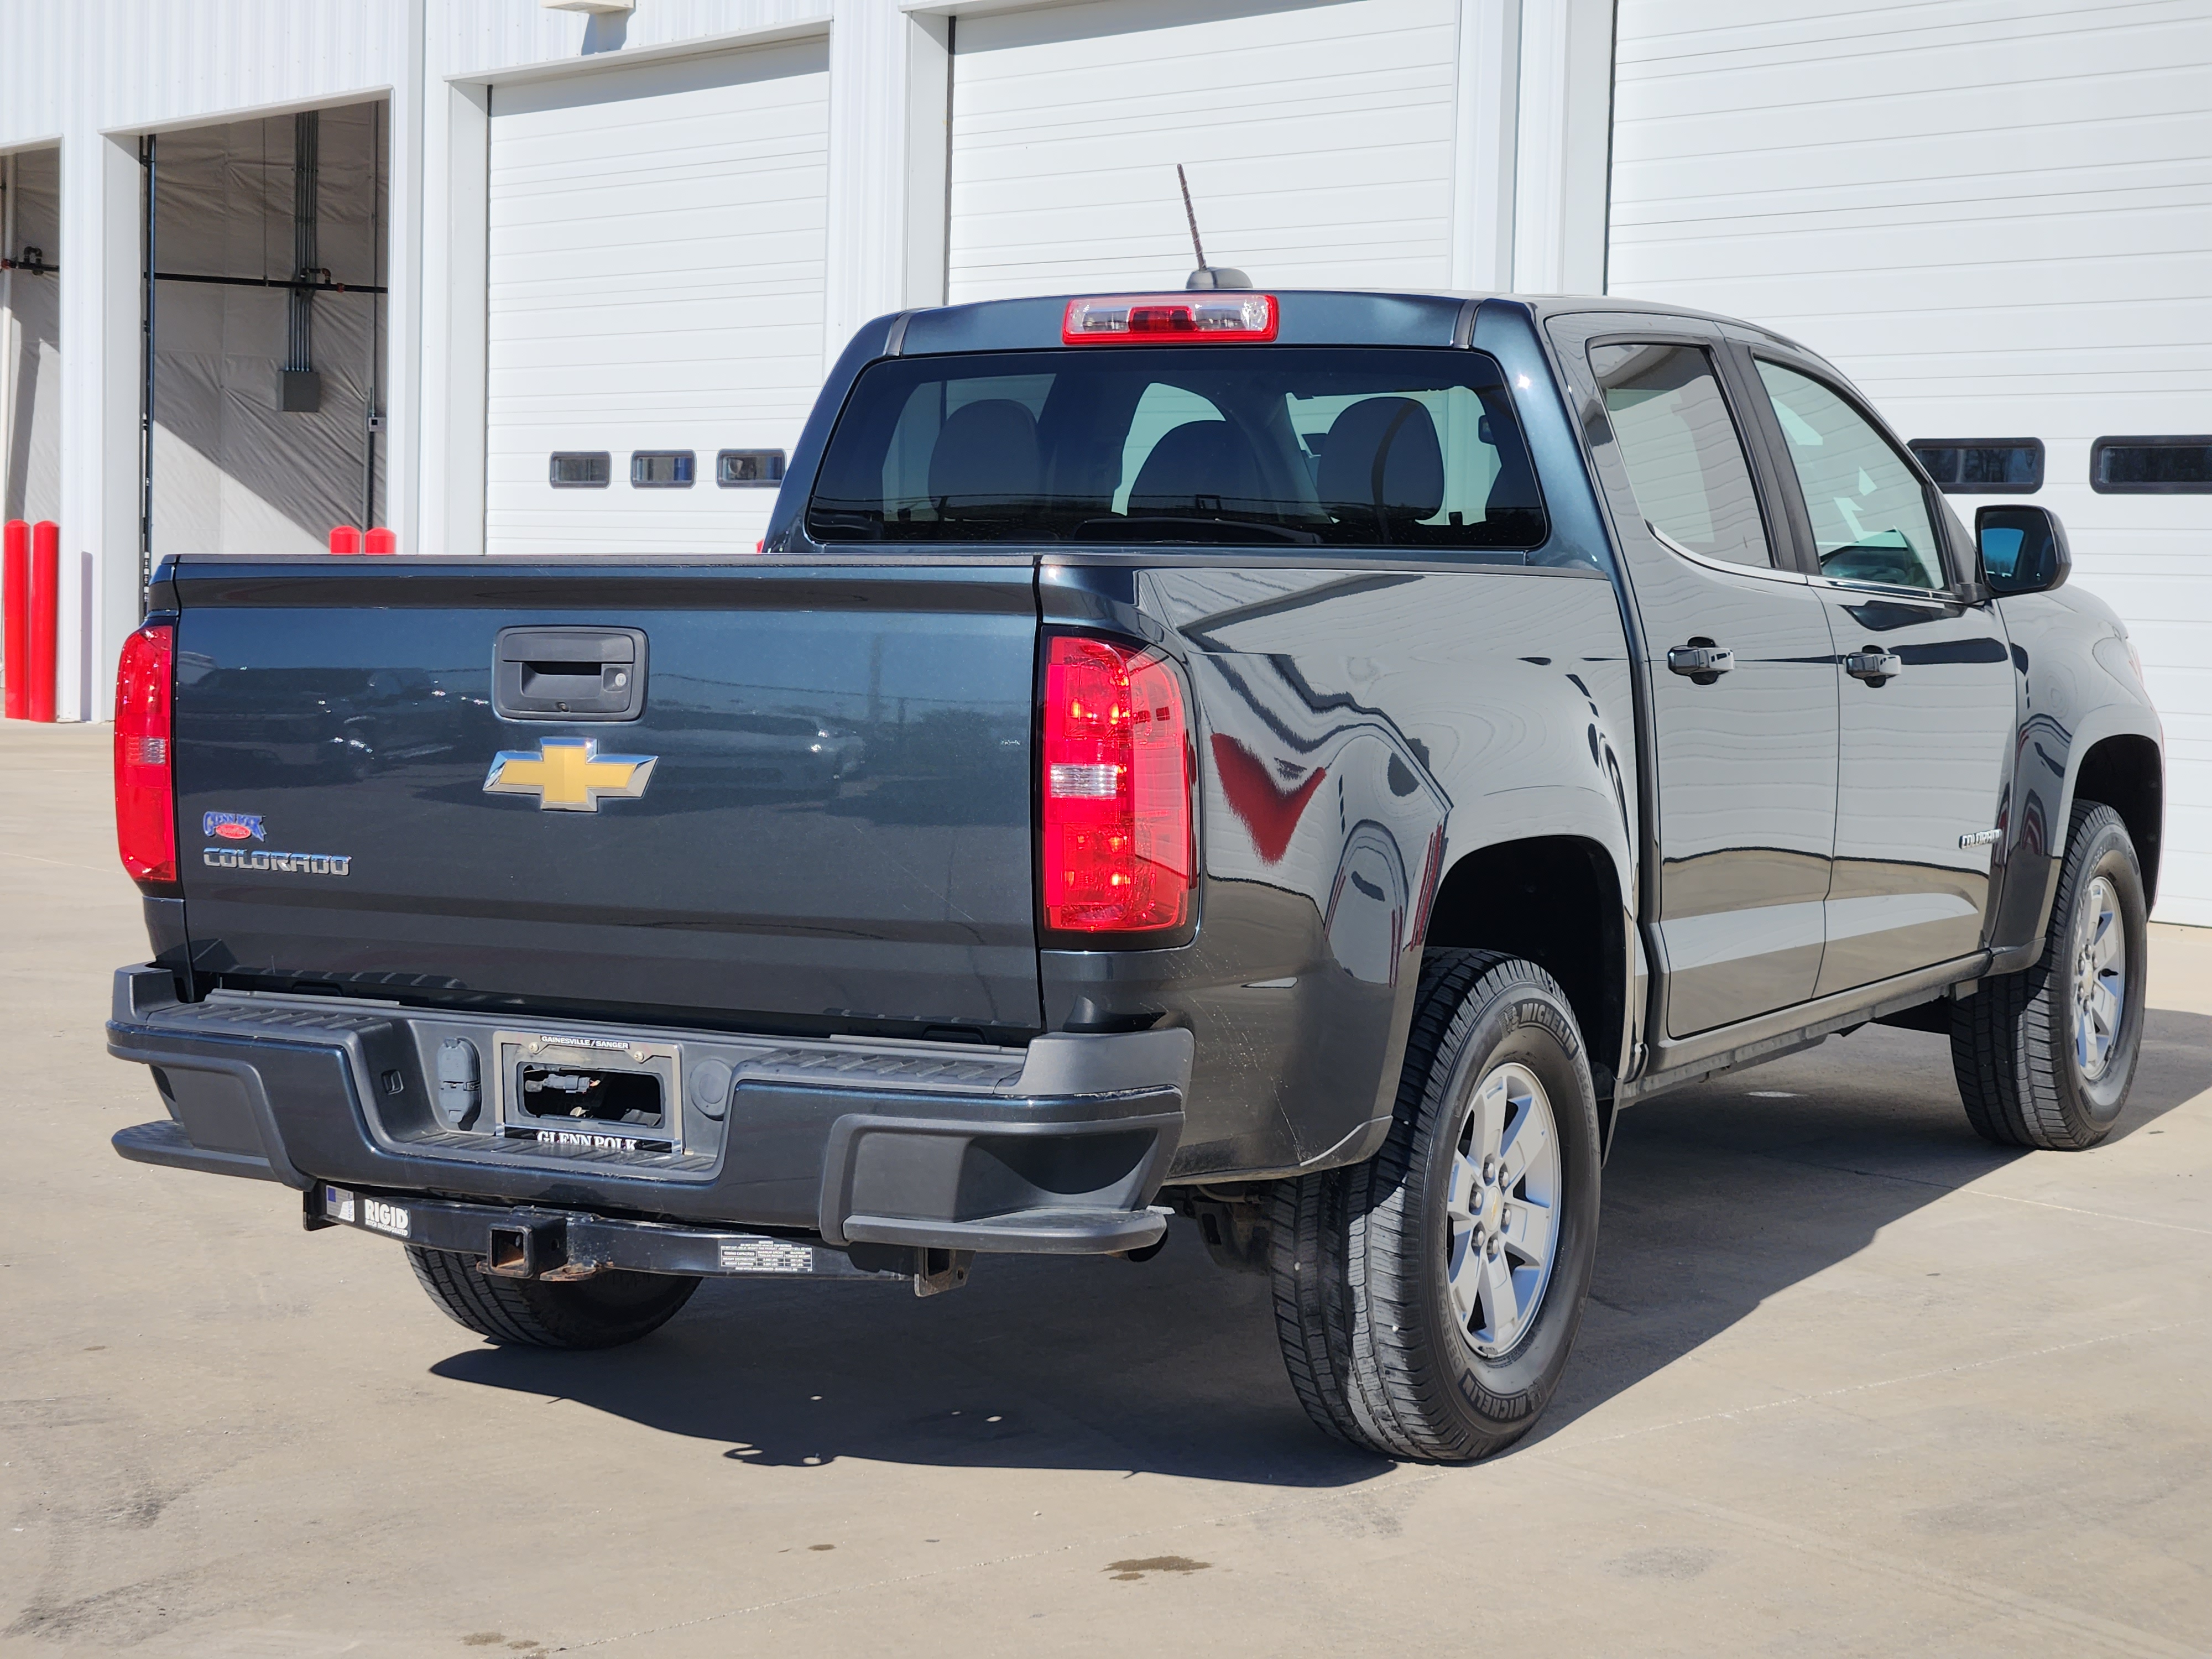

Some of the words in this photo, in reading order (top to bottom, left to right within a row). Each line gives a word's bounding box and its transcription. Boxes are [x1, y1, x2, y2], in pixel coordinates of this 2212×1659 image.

[1959, 828, 2003, 849] COLORADO
[204, 847, 352, 876] COLORADO
[1520, 1003, 1577, 1055] MICHELIN
[537, 1131, 591, 1146] GLENN
[593, 1136, 637, 1151] POLK
[365, 1199, 408, 1229] RIGID
[1462, 1374, 1527, 1420] MICHELIN
